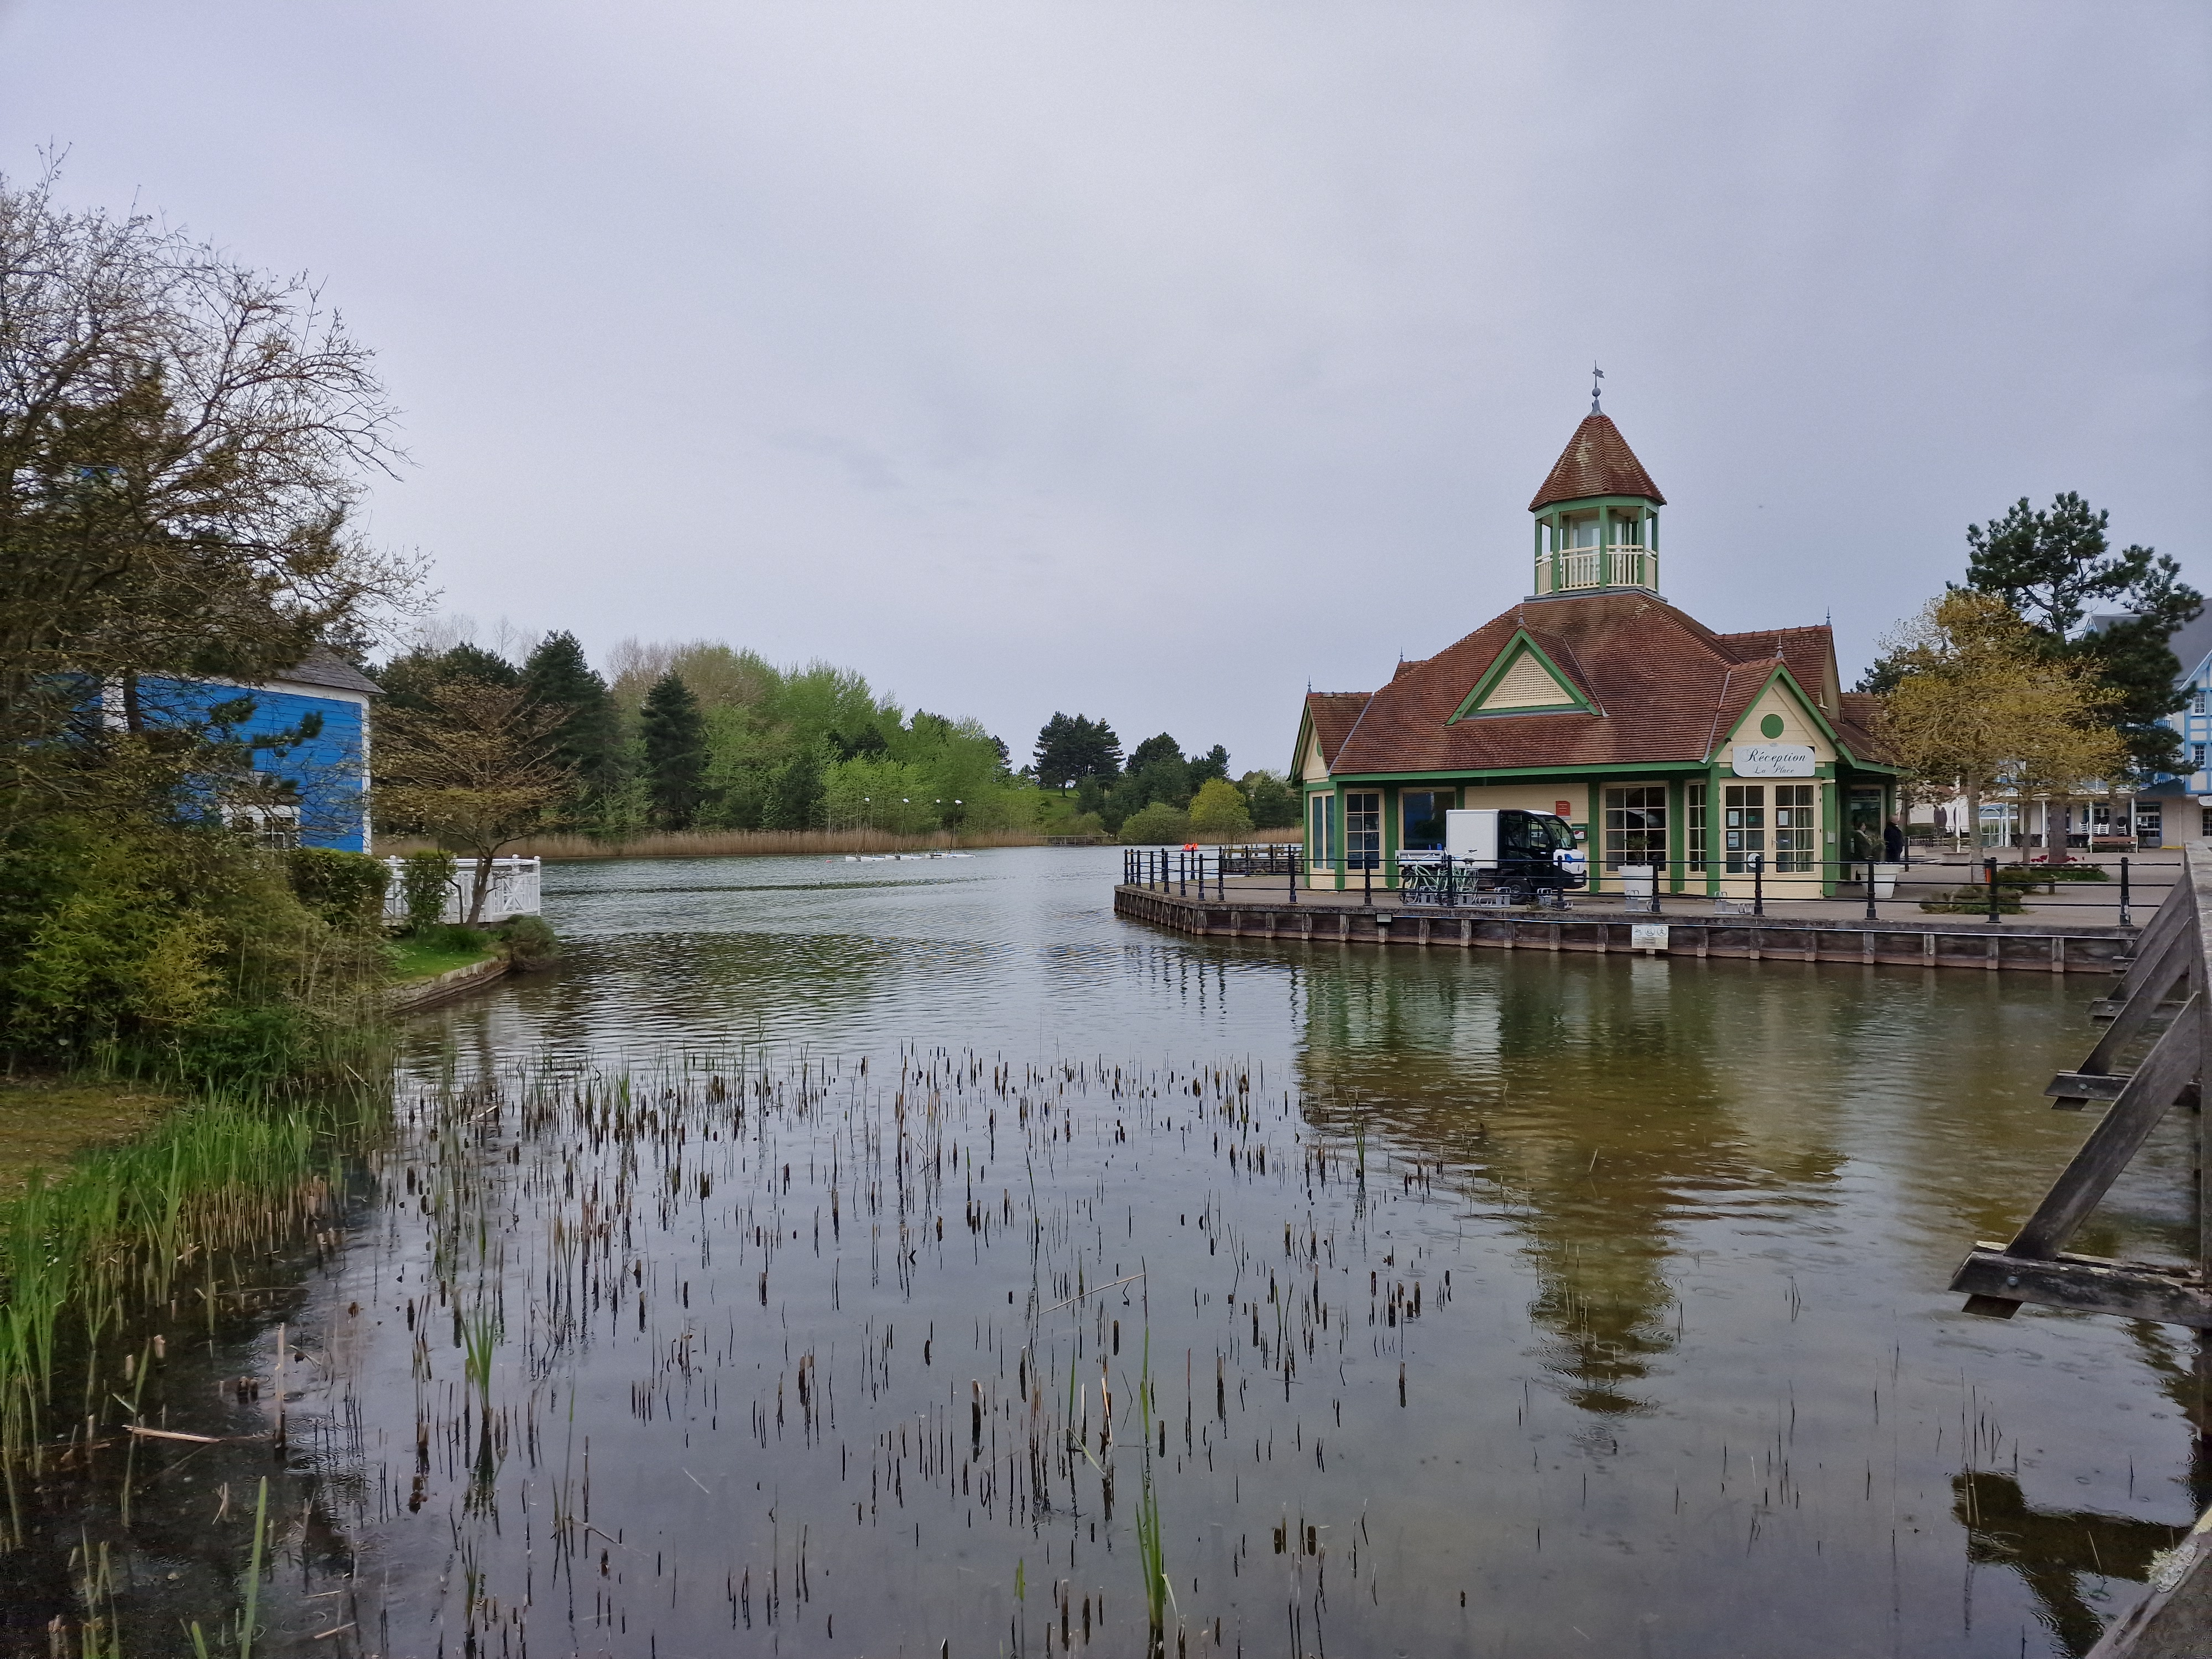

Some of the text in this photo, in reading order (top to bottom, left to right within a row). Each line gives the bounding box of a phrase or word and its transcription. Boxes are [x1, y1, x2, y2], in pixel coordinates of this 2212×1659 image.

[1740, 748, 1807, 768] Réception
[1754, 764, 1794, 774] La Place
